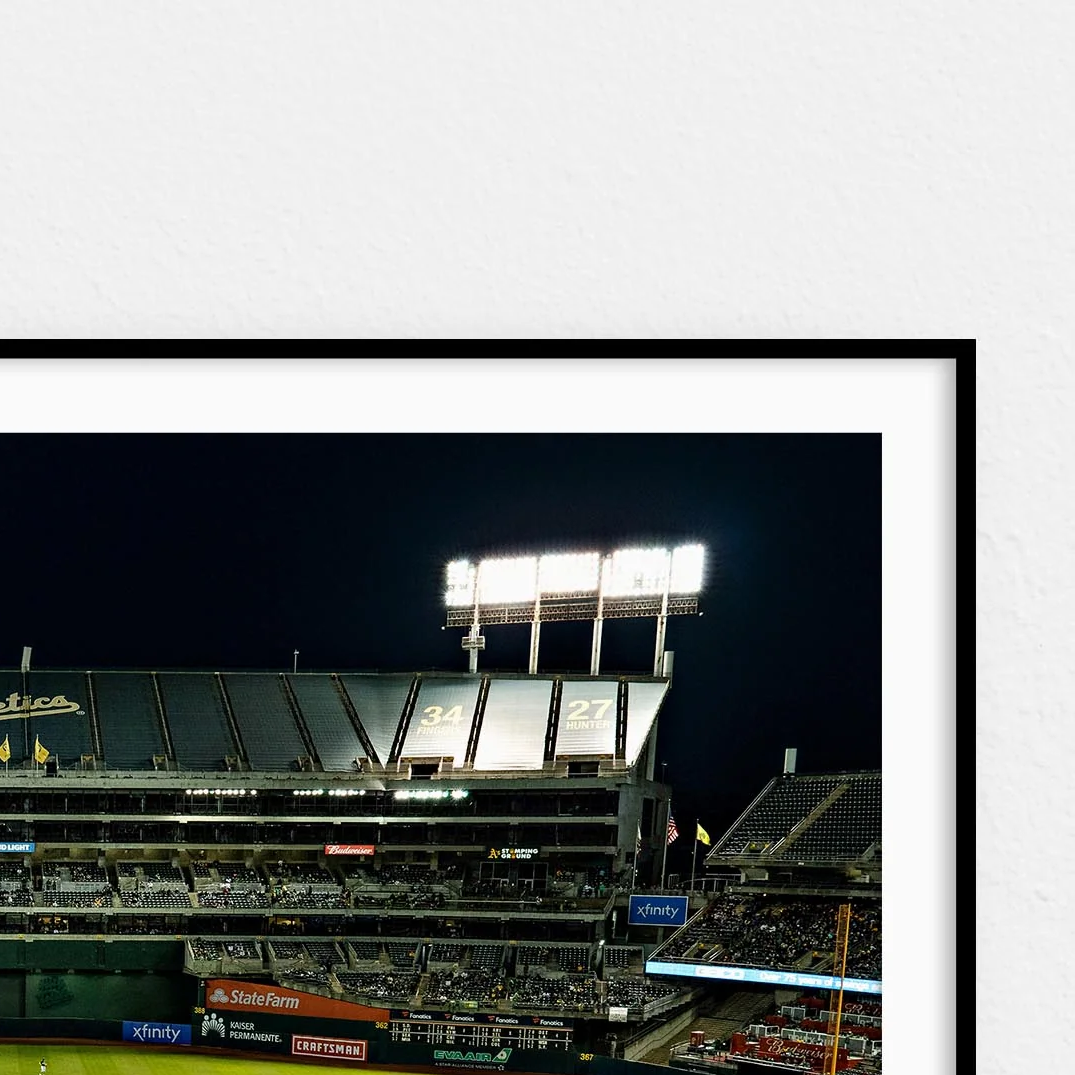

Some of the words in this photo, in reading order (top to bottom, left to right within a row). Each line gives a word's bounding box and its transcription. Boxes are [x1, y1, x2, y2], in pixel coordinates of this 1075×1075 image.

[420, 705, 464, 728] 34
[566, 699, 614, 721] 27
[416, 725, 462, 736] FING
[565, 719, 611, 731] HUNTER
[327, 845, 374, 855] Budweiser
[636, 903, 679, 919] xfinity
[230, 1021, 255, 1031] KAISER
[375, 1021, 388, 1029] 362
[409, 1012, 432, 1020] Fanatics
[452, 1014, 475, 1022] Fanatics
[495, 1016, 519, 1024] Fanatics
[539, 1019, 564, 1027] Fanatics
[133, 1024, 181, 1043] xfinity
[229, 1030, 280, 1043] PERMANENTE
[296, 1040, 360, 1055] CRAFTSMAN
[579, 1053, 594, 1061] 367
